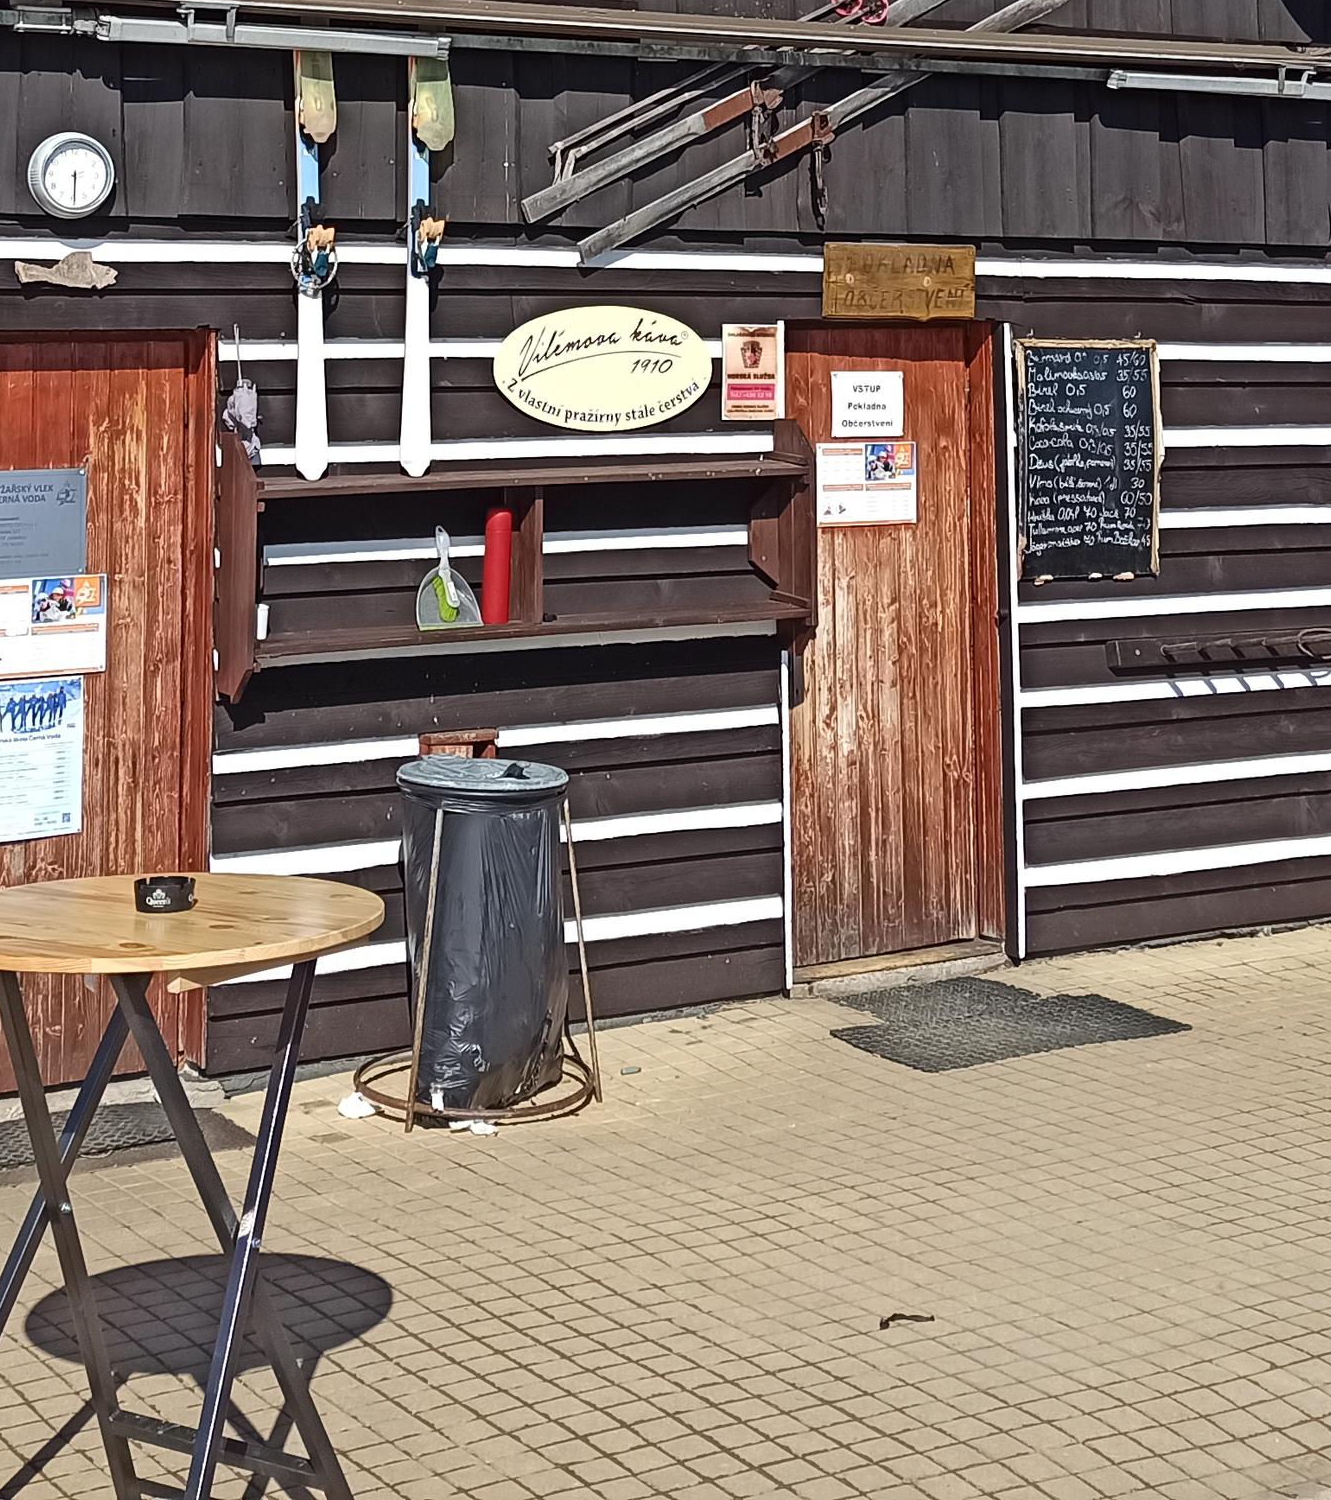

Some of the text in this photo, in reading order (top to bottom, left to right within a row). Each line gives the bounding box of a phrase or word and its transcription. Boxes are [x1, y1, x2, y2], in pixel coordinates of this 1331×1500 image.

[518, 318, 683, 377] Vilémova káva
[630, 358, 674, 375] 1910
[852, 384, 881, 393] VSTUP
[1027, 382, 1137, 399] Birel 0,5 60
[518, 388, 563, 418] vlastní
[564, 408, 622, 428] pražírny
[625, 404, 656, 422] stále
[657, 378, 700, 414] čerstvá
[1093, 403, 1111, 417] 0,5
[1122, 402, 1138, 419] 60
[33, 484, 54, 493] VLEK
[1130, 477, 1145, 489] 30
[22, 494, 46, 503] VODA
[1124, 507, 1136, 519] 70
[1084, 521, 1097, 532] 70
